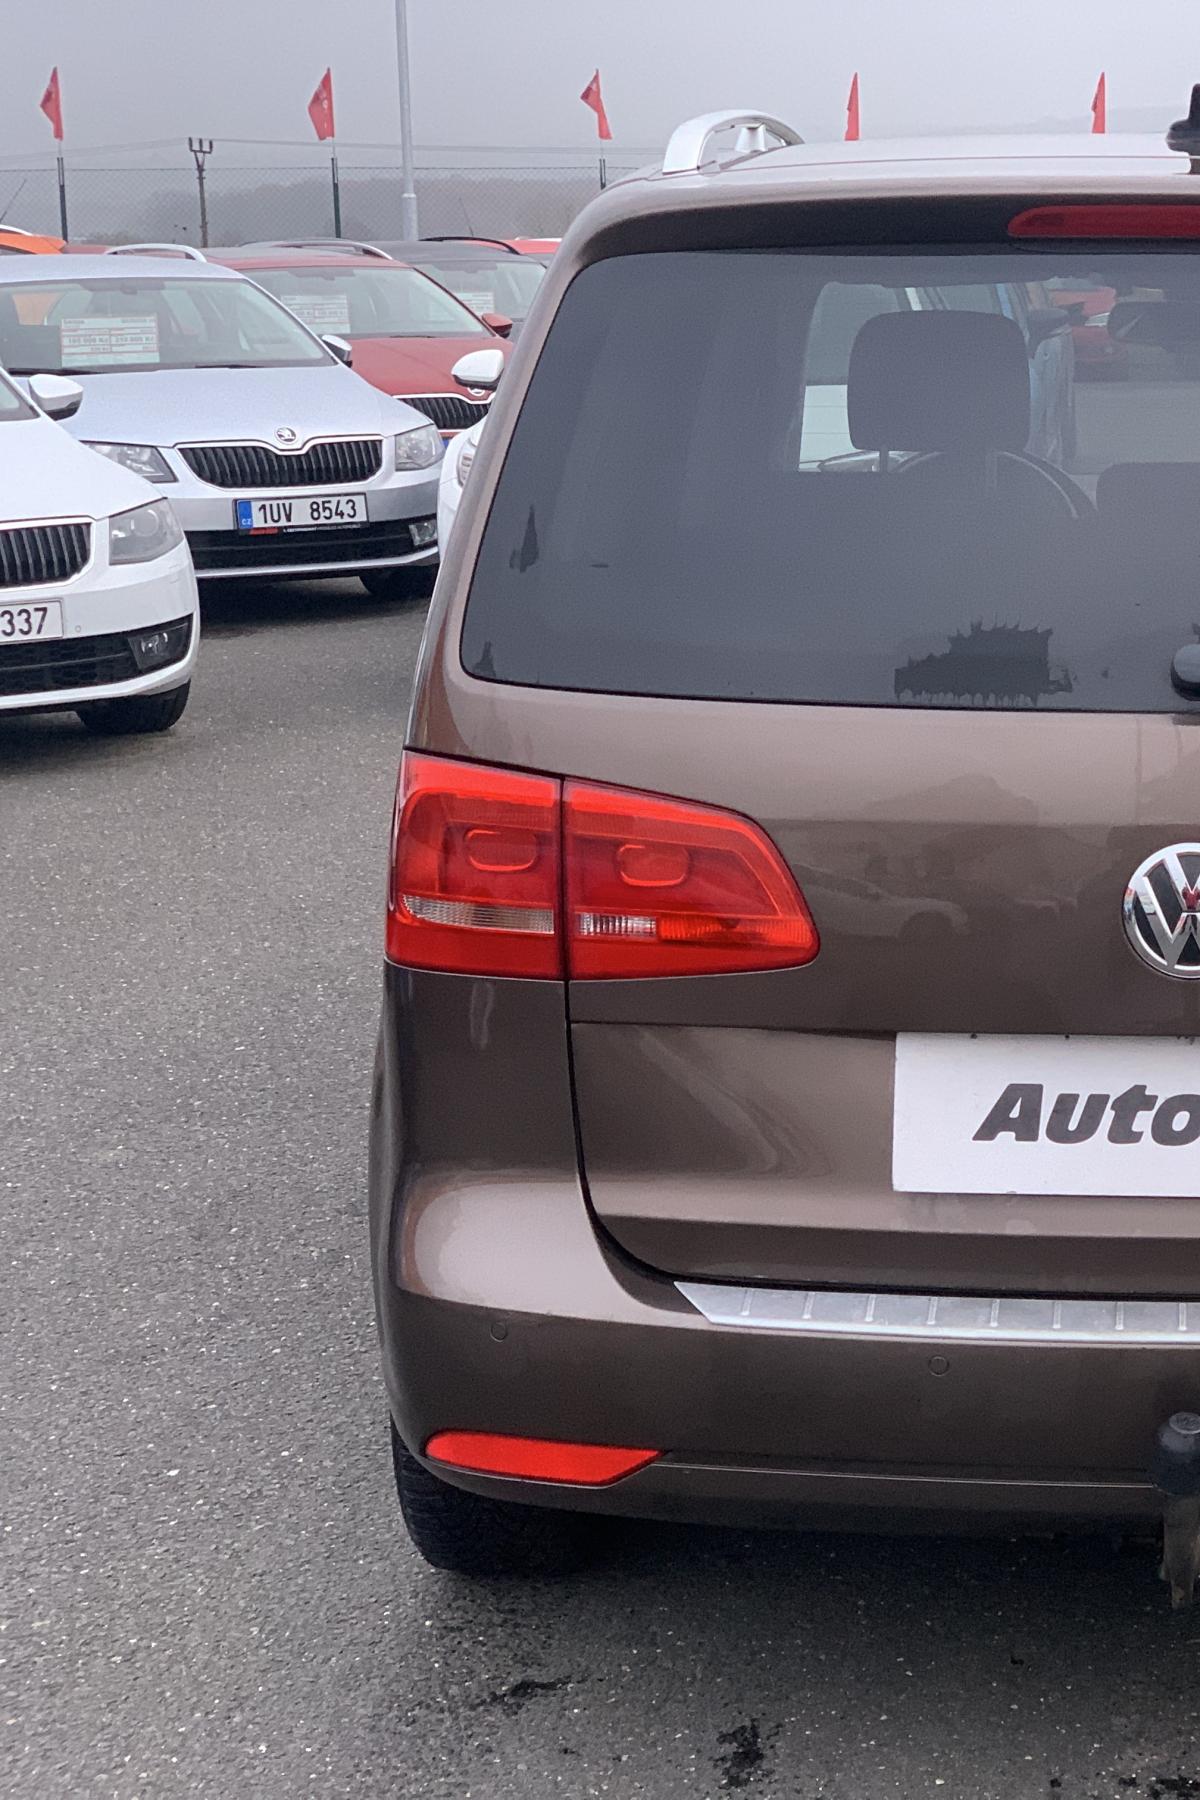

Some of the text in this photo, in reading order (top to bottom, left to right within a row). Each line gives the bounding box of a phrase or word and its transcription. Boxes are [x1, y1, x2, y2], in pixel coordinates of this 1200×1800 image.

[258, 499, 357, 524] 1UV 8543
[0, 607, 48, 637] 337
